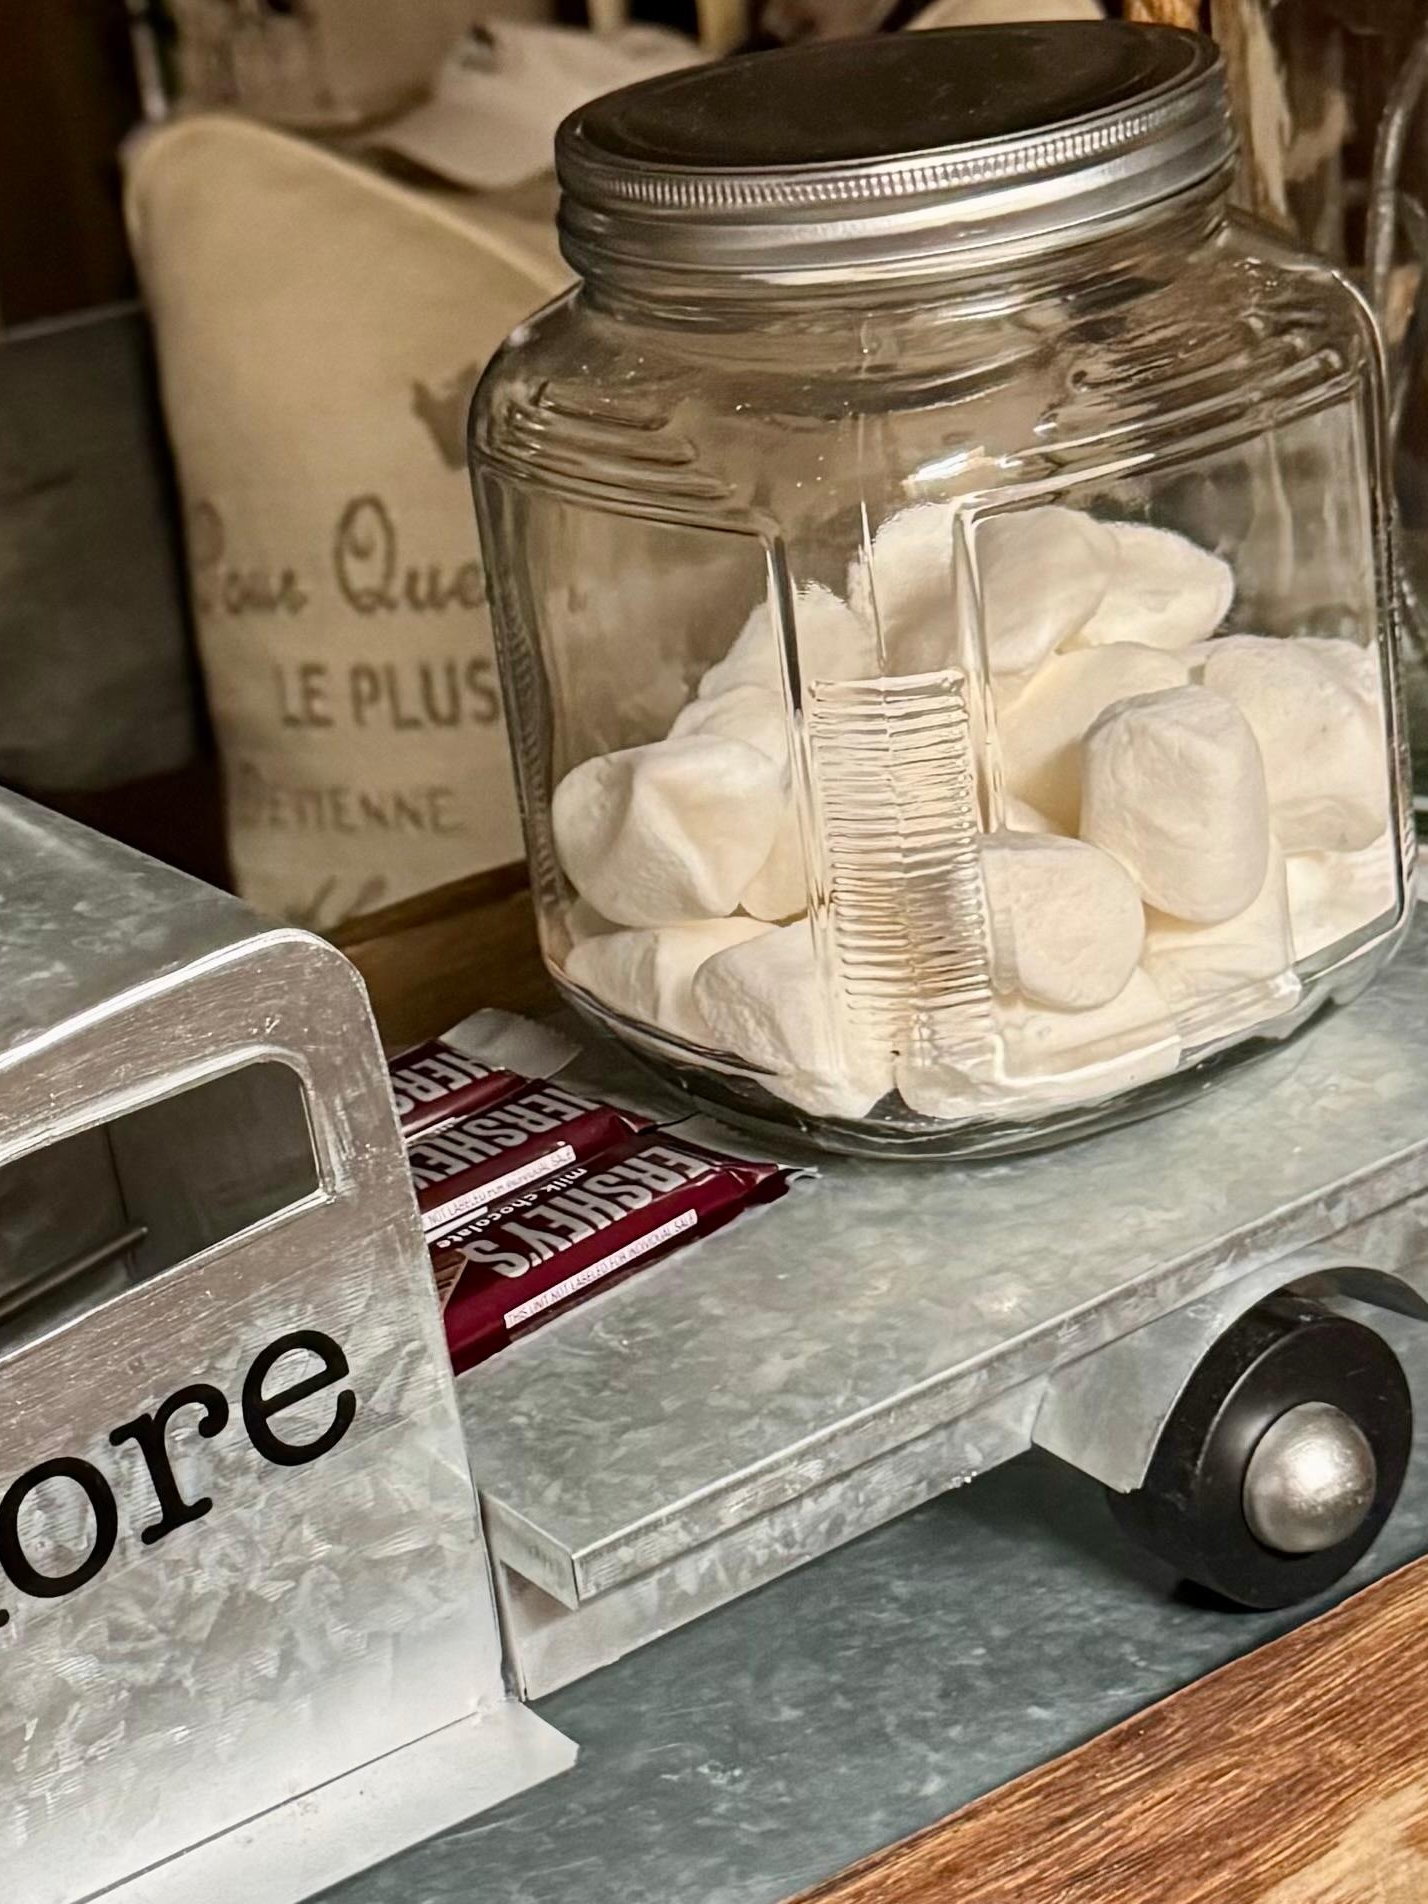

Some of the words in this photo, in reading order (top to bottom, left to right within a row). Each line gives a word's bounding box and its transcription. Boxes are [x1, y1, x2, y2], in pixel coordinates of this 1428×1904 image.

[276, 662, 336, 728] LE
[349, 657, 498, 730] PLUS
[547, 1167, 588, 1194] milk
[438, 1193, 538, 1249] chocolate
